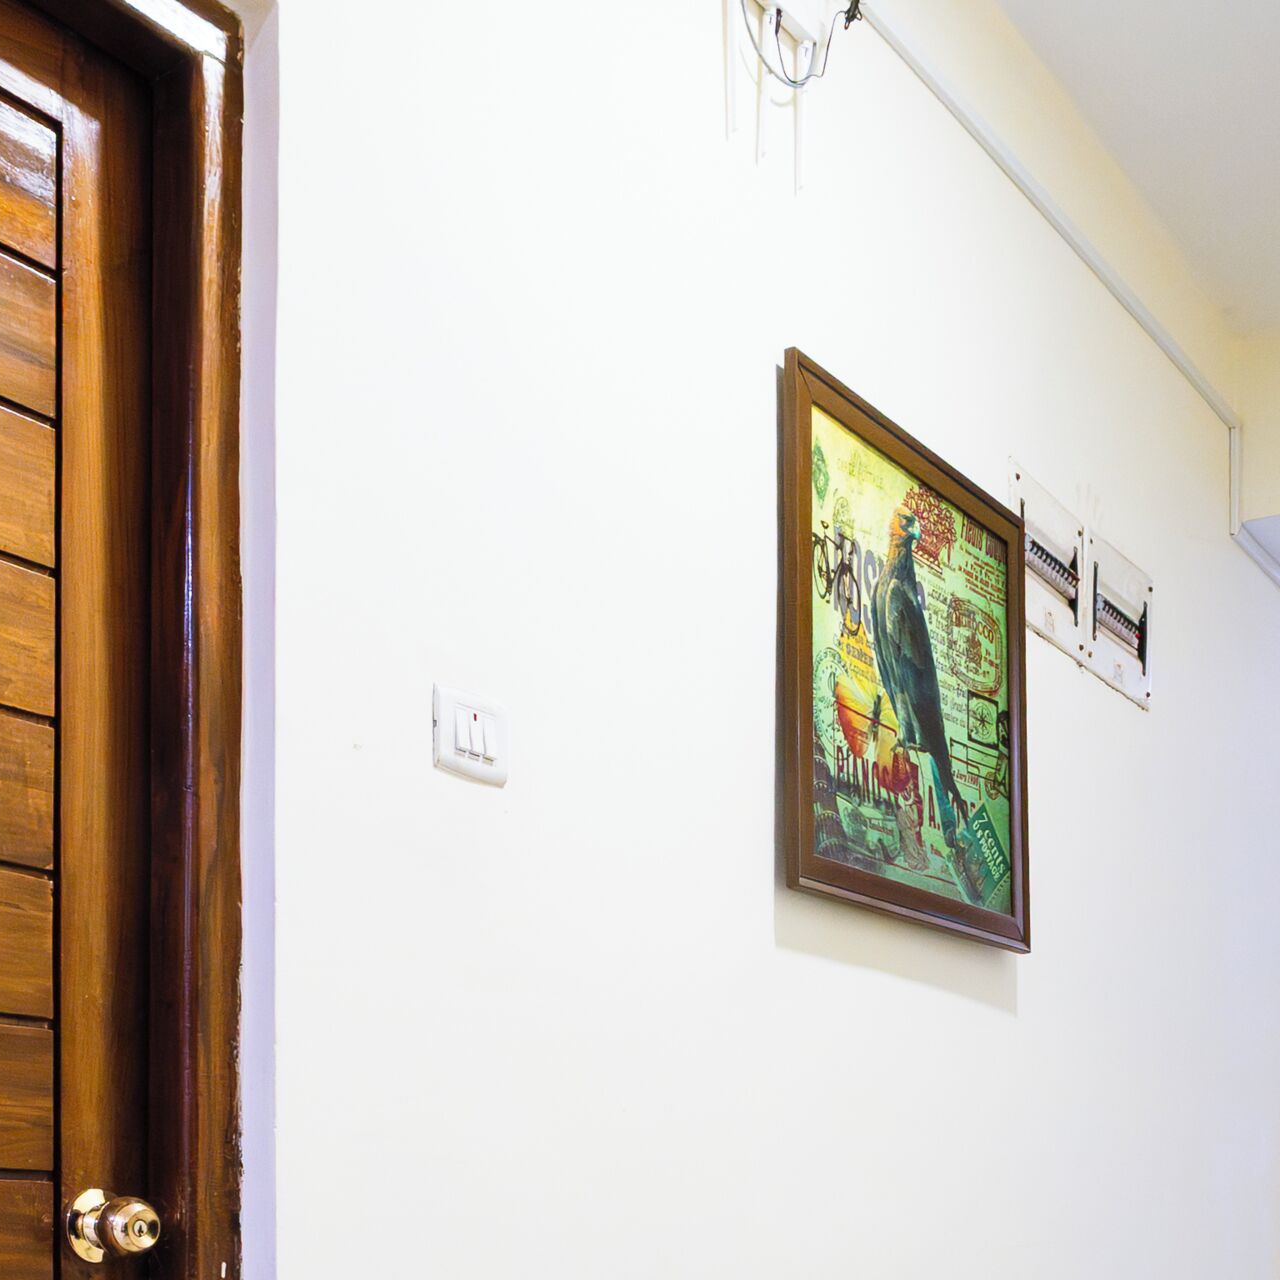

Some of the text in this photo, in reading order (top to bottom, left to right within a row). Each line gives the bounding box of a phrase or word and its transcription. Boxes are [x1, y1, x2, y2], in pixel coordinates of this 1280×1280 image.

[978, 812, 1005, 874] 7 cents
[979, 837, 1001, 882] POSTAGE
